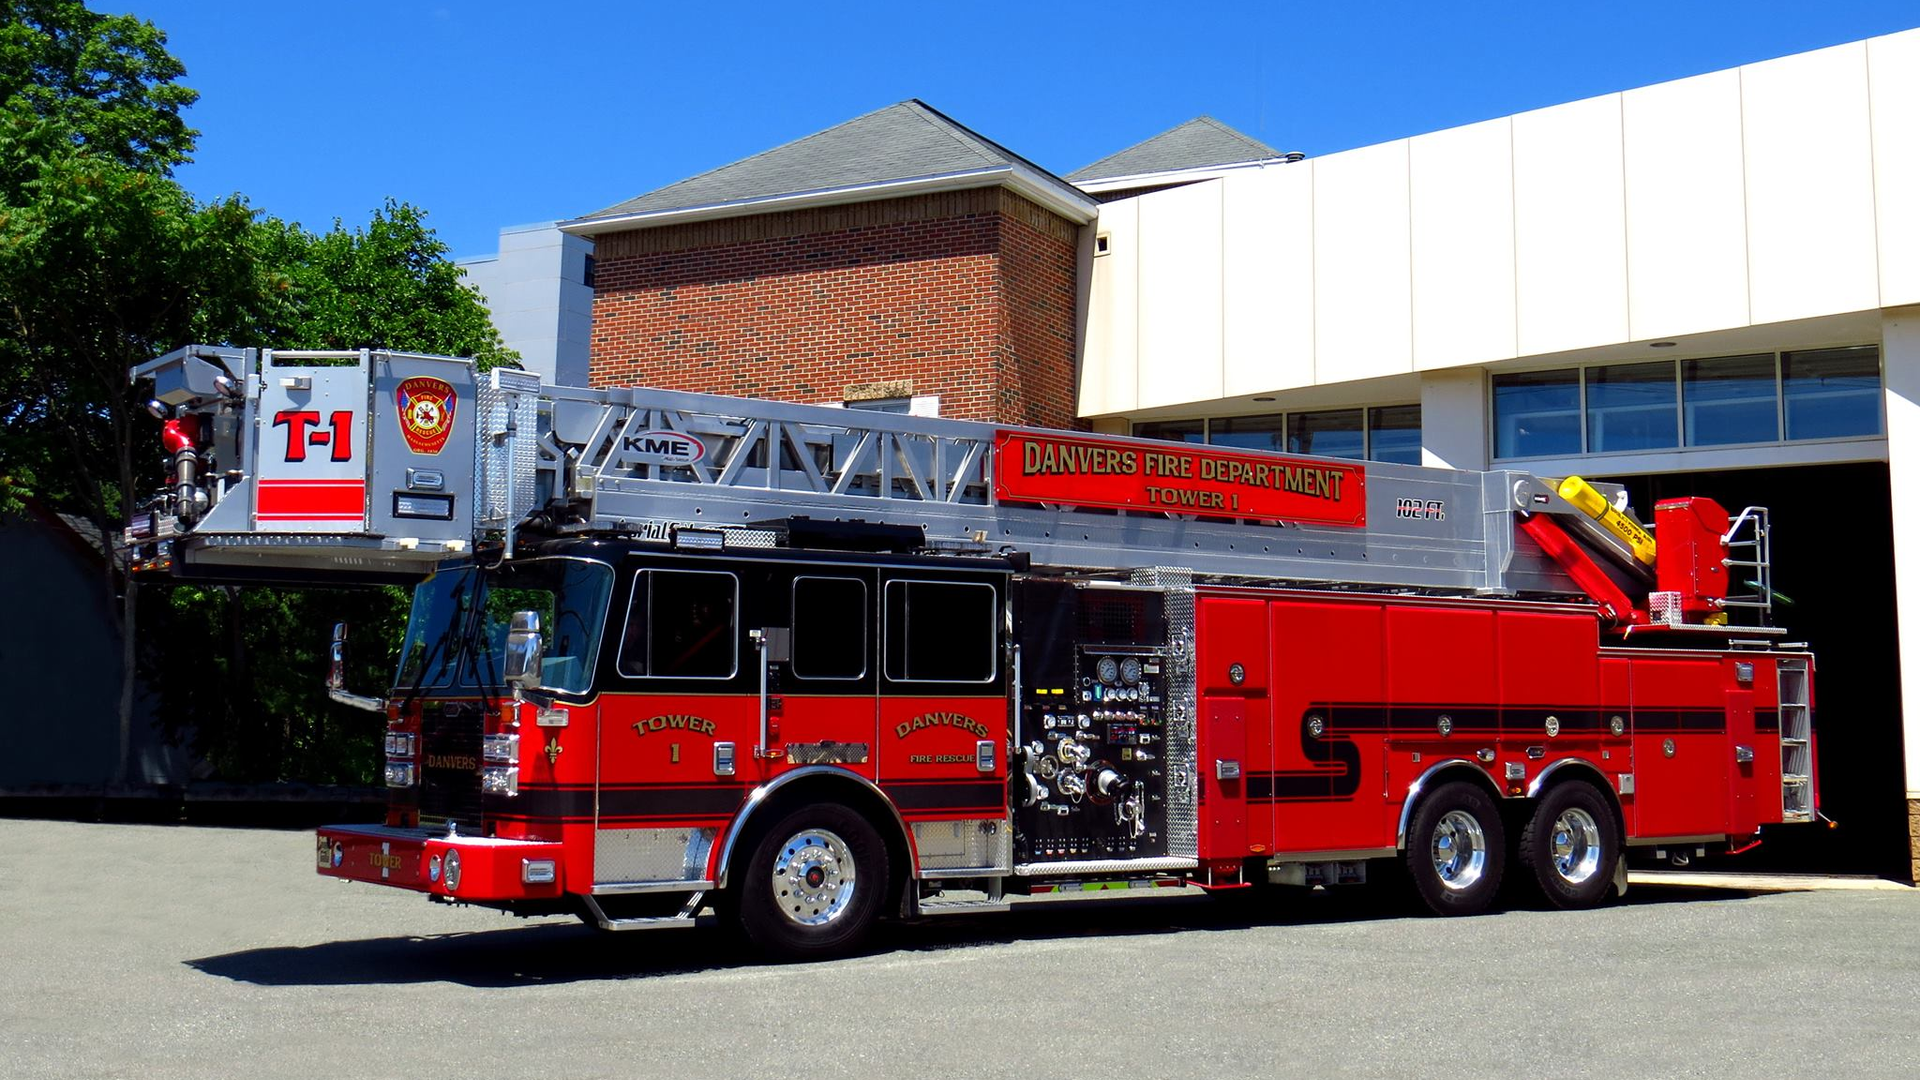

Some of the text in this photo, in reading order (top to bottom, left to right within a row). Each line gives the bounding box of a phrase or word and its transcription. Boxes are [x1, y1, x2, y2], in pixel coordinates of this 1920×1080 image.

[405, 380, 451, 394] DANVERS
[272, 410, 353, 462] T-1
[623, 436, 690, 456] KME
[1024, 441, 1343, 500] DANVERS FIRE DEPARTMENT
[1147, 486, 1238, 509] TOWER 1
[1397, 498, 1422, 519] 102
[1616, 520, 1632, 535] 4500
[1633, 533, 1643, 545] PSI
[632, 714, 716, 736] TOWER
[896, 712, 989, 738] DANVERS
[428, 754, 476, 770] DANVERS
[671, 743, 679, 762] 1
[911, 755, 975, 763] FIRE RESCUE
[369, 852, 401, 869] TOWER
